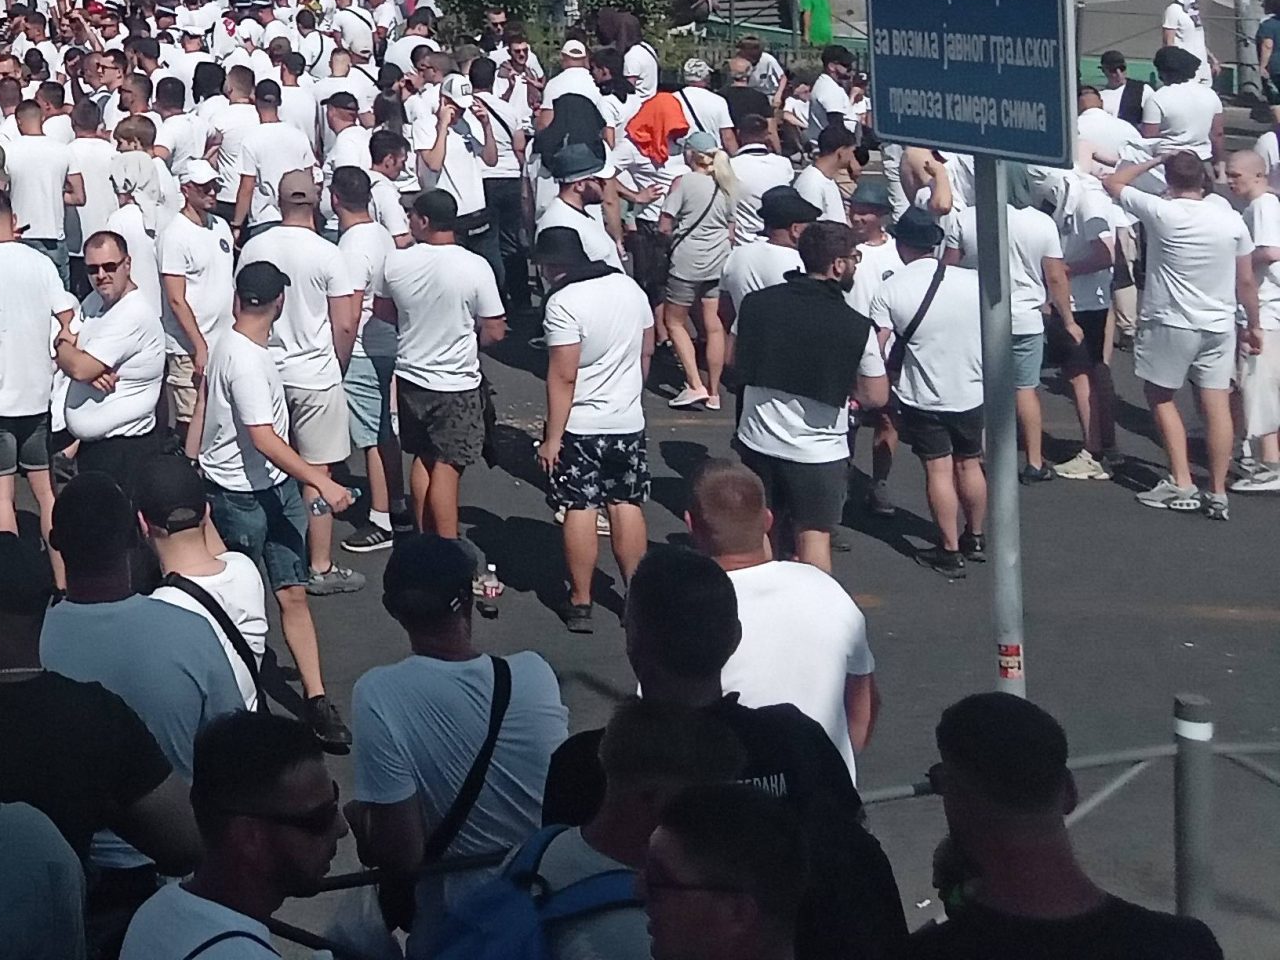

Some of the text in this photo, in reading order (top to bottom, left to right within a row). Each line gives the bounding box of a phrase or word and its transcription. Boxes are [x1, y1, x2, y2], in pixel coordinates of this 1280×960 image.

[874, 22, 1058, 74] за возила јавног градског
[889, 87, 1047, 135] превоза камера снима
